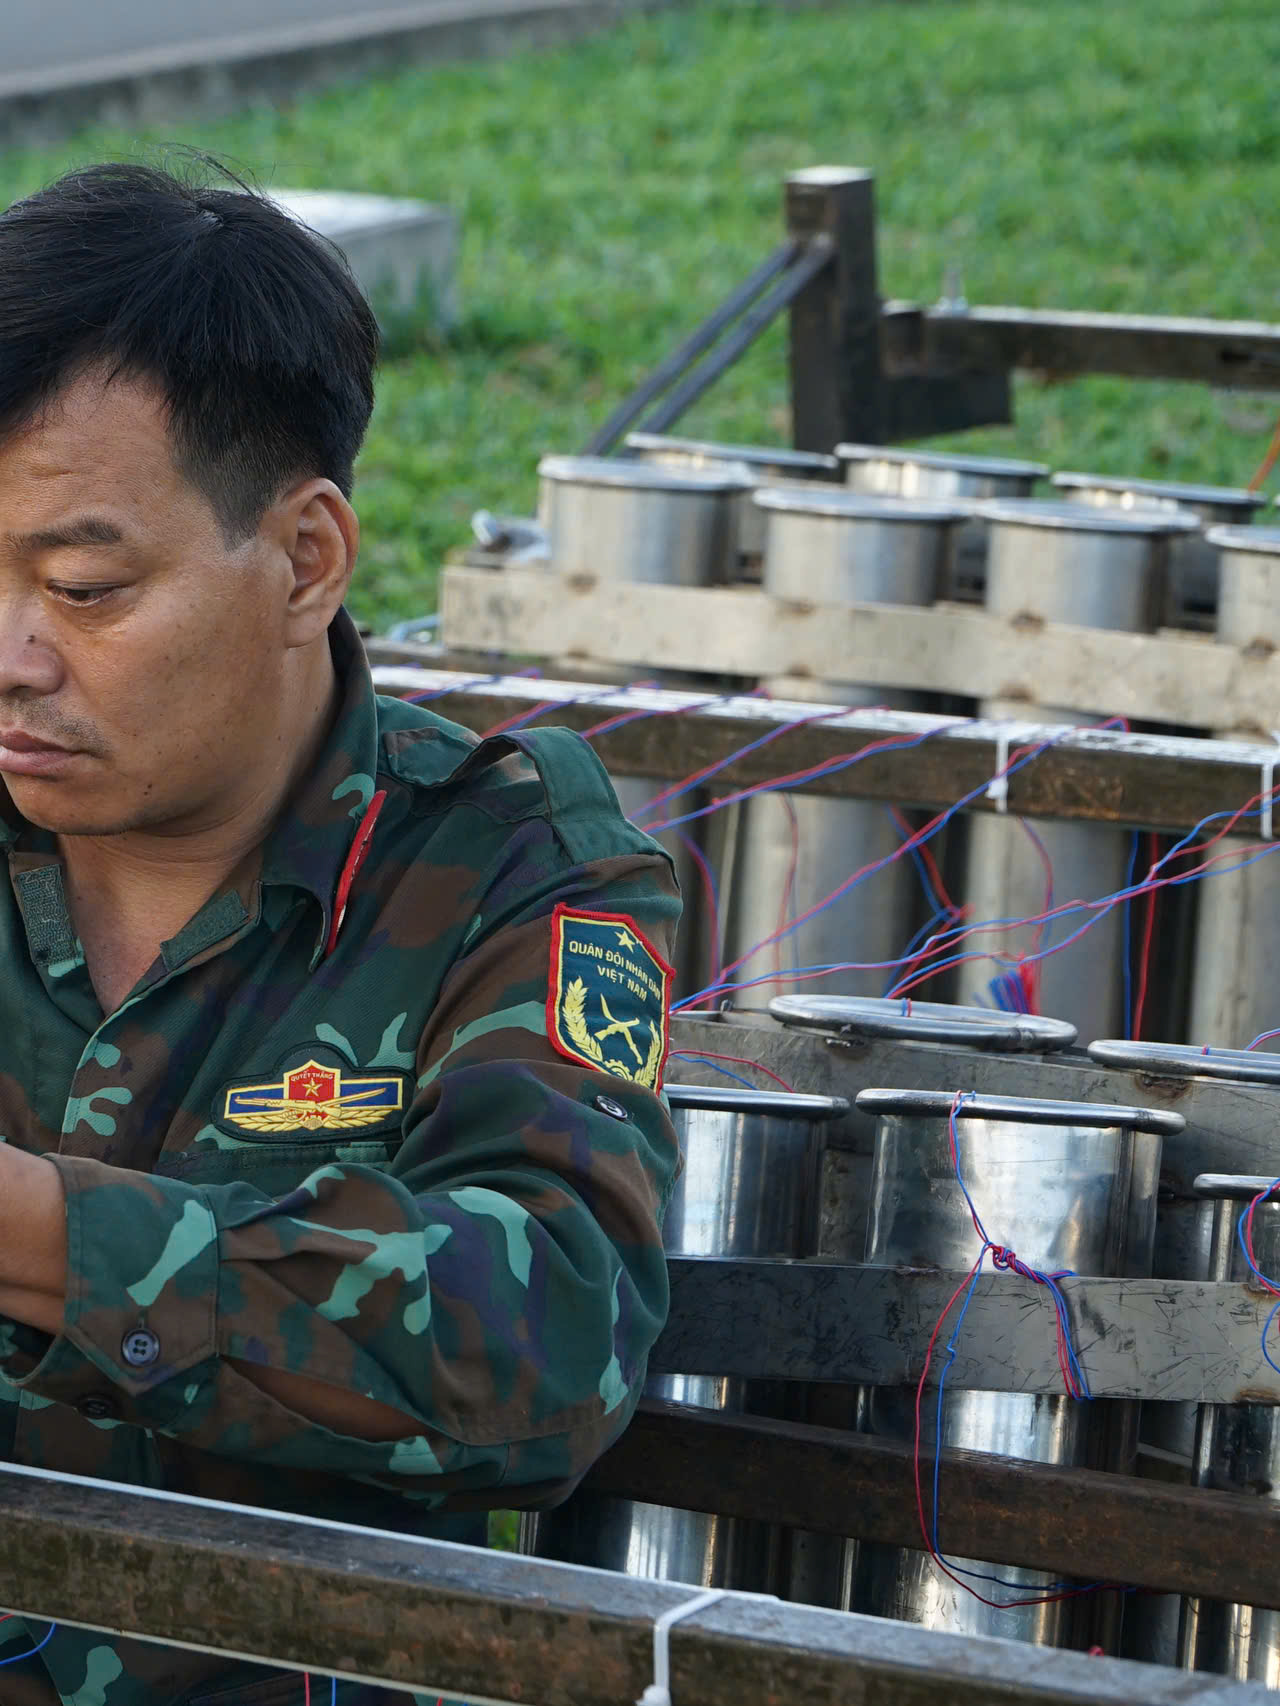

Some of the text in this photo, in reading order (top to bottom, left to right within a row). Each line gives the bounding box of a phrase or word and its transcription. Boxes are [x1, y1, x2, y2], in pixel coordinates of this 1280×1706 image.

[569, 940, 603, 959] QUÂN
[605, 950, 624, 967] ĐỘI
[625, 959, 649, 984] NHÂN
[597, 965, 648, 1002] VIỆT NAM
